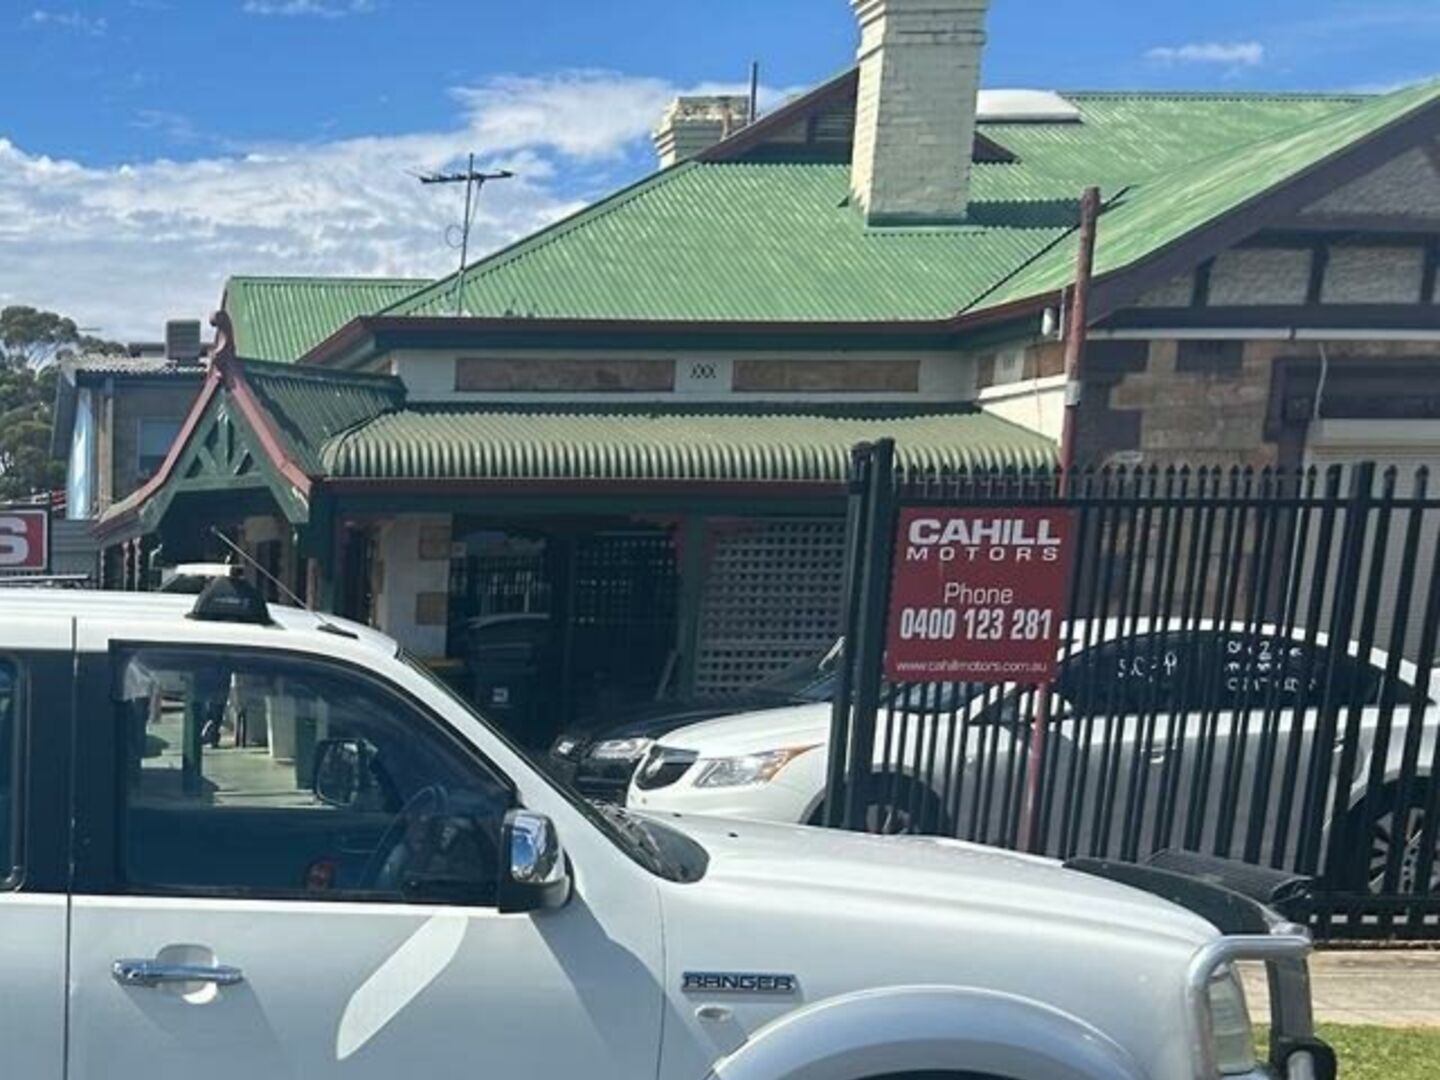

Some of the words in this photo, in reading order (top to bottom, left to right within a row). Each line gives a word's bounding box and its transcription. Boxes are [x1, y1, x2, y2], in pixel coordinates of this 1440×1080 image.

[909, 518, 1062, 545] CAHILL
[906, 547, 1059, 561] MOTORS
[944, 582, 1014, 605] Phone
[900, 608, 957, 640] 0400
[964, 608, 1005, 640] 123
[1010, 608, 1052, 640] 281
[682, 971, 796, 991] RANGER
